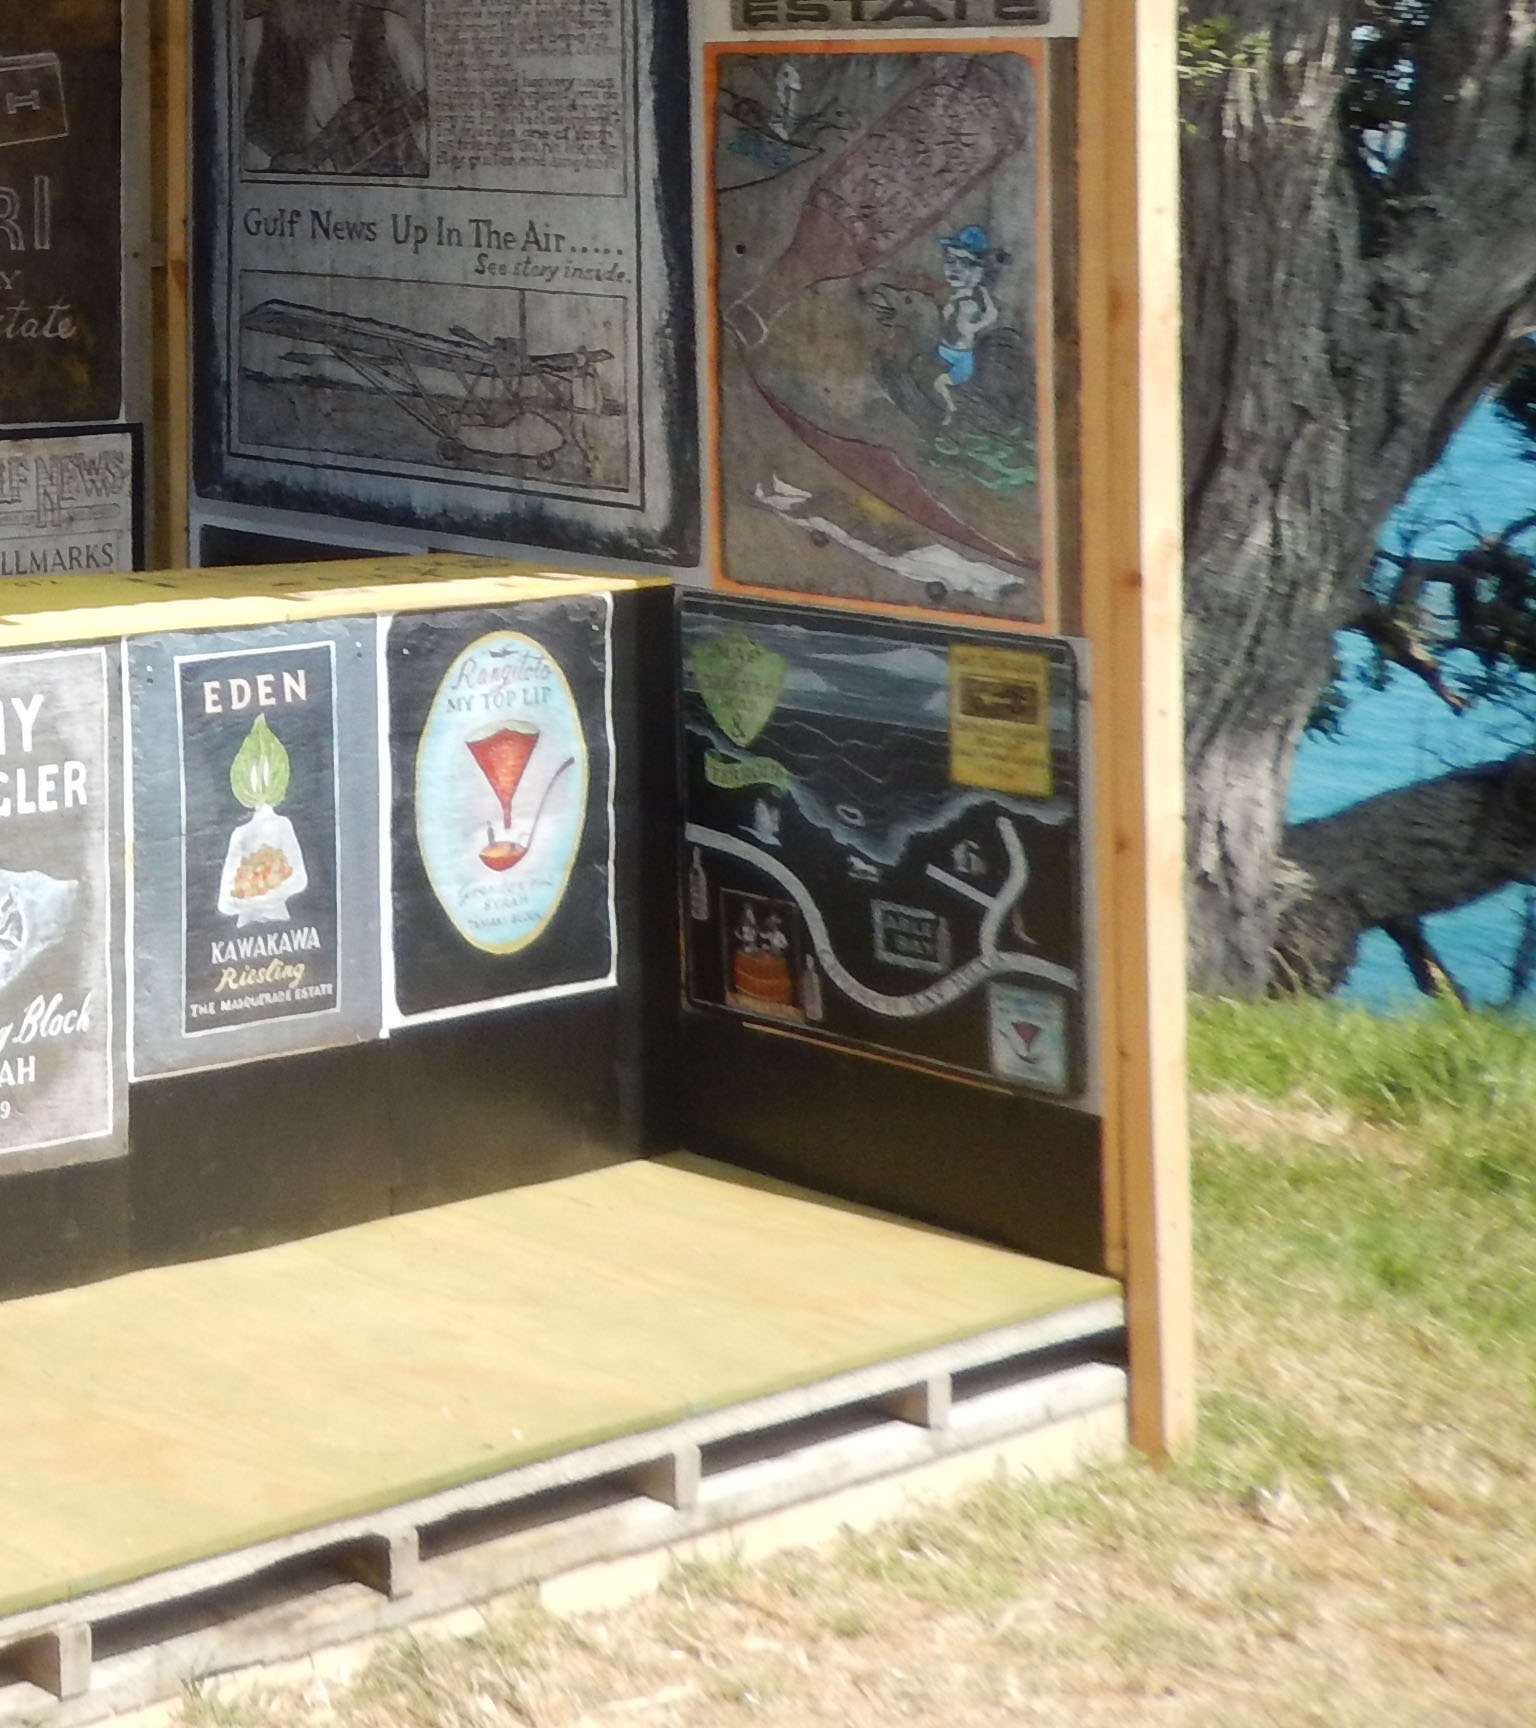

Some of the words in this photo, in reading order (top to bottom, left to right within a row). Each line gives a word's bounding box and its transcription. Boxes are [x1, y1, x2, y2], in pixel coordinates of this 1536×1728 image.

[243, 208, 301, 239] Gulf
[310, 210, 377, 244] News
[392, 213, 428, 255] Up
[437, 216, 463, 247] In
[469, 218, 516, 251] The
[475, 252, 507, 276] See
[203, 669, 307, 715] EDEN
[447, 695, 475, 713] MY
[481, 690, 516, 710] TOP
[522, 686, 552, 705] LIP
[211, 926, 321, 965] KAWAKAWA
[214, 958, 305, 993] Riesling
[294, 983, 333, 1000] ESTATE
